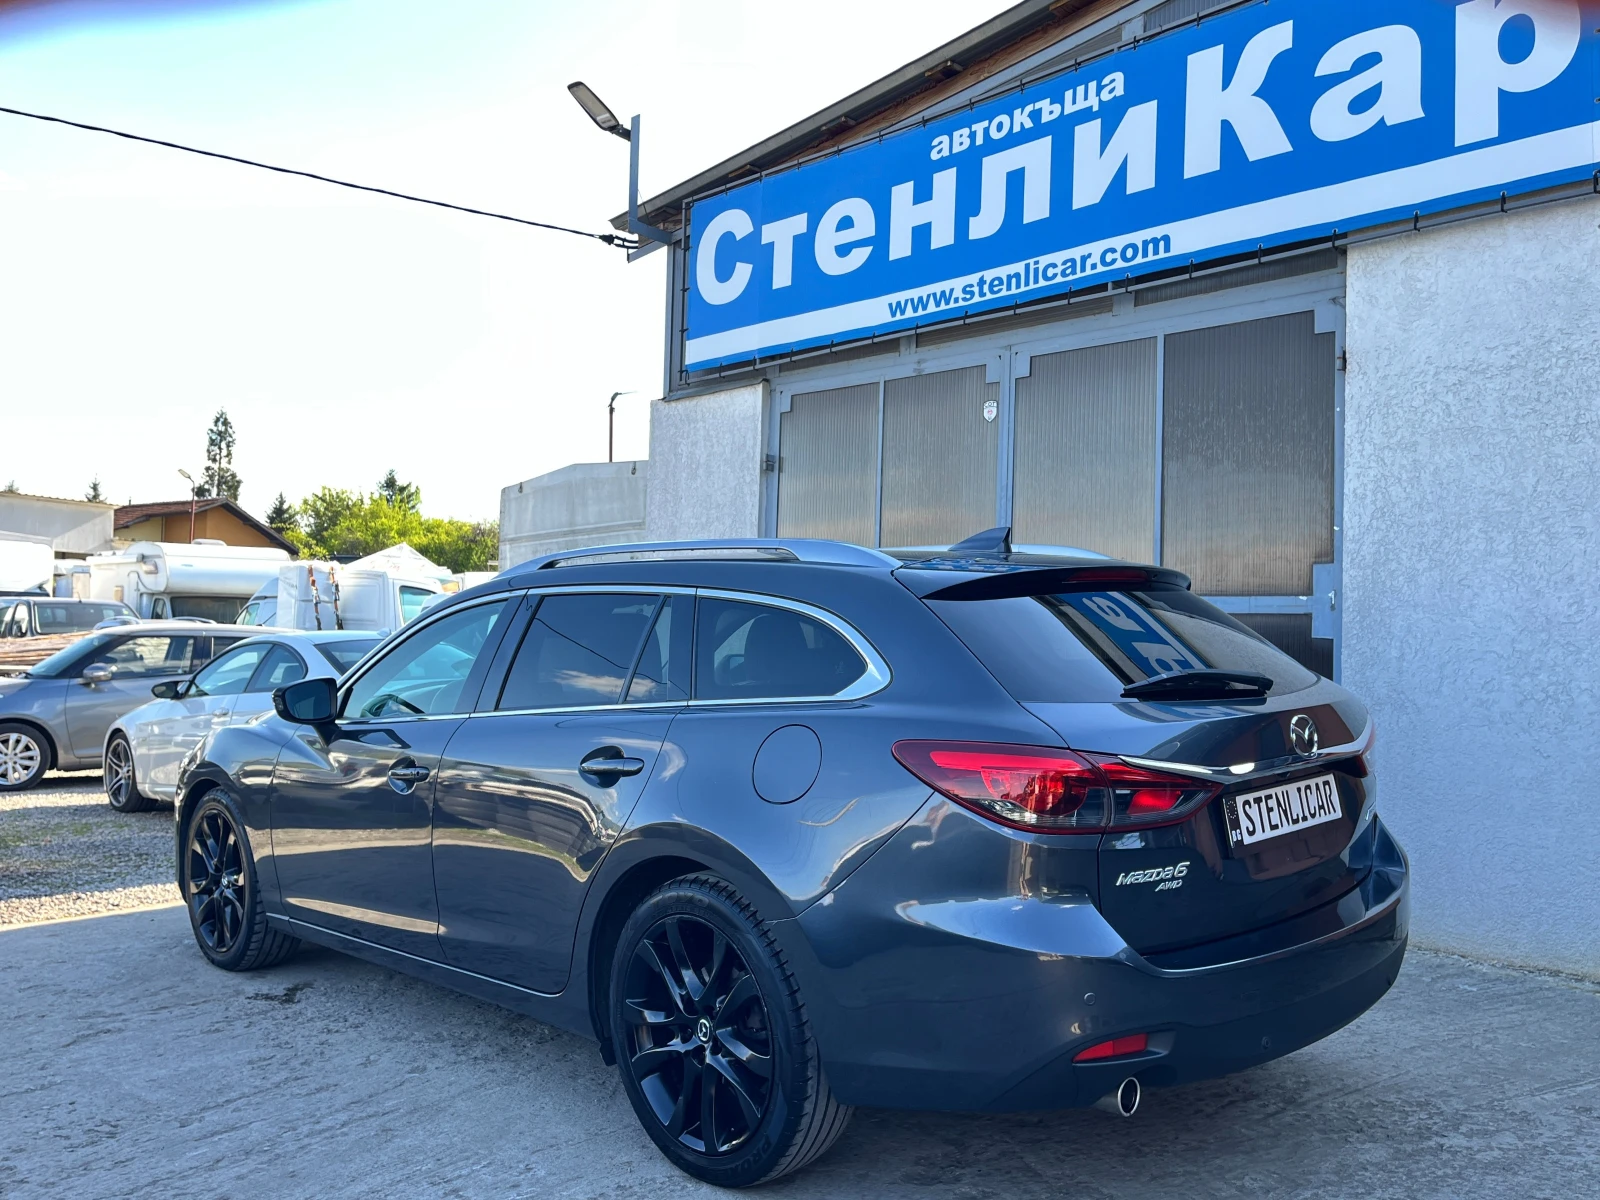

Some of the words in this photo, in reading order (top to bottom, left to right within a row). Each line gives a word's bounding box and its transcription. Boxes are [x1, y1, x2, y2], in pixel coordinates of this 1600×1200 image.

[930, 71, 1125, 161] автокъща
[696, 0, 1581, 306] СтенлиКар
[888, 230, 1171, 319] www.stenlicar.com
[1232, 829, 1242, 842] BG
[1242, 780, 1337, 837] STENLICAR
[1155, 879, 1183, 892] AWD
